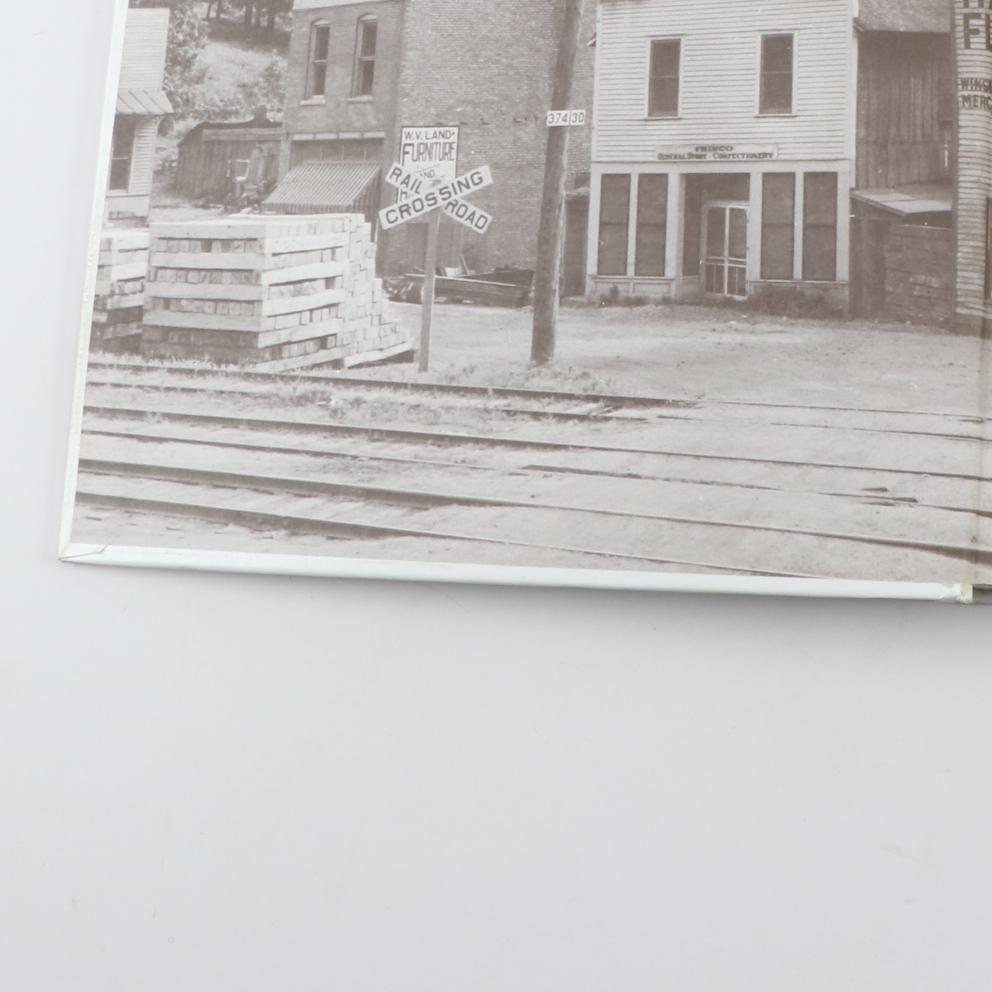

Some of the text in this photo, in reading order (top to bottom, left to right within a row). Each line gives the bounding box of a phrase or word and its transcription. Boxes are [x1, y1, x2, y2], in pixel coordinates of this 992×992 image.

[549, 112, 568, 125] 374
[402, 141, 456, 167] FURNITURE
[385, 170, 484, 225] CROSSING
[389, 166, 489, 230] RAIL ROAD
